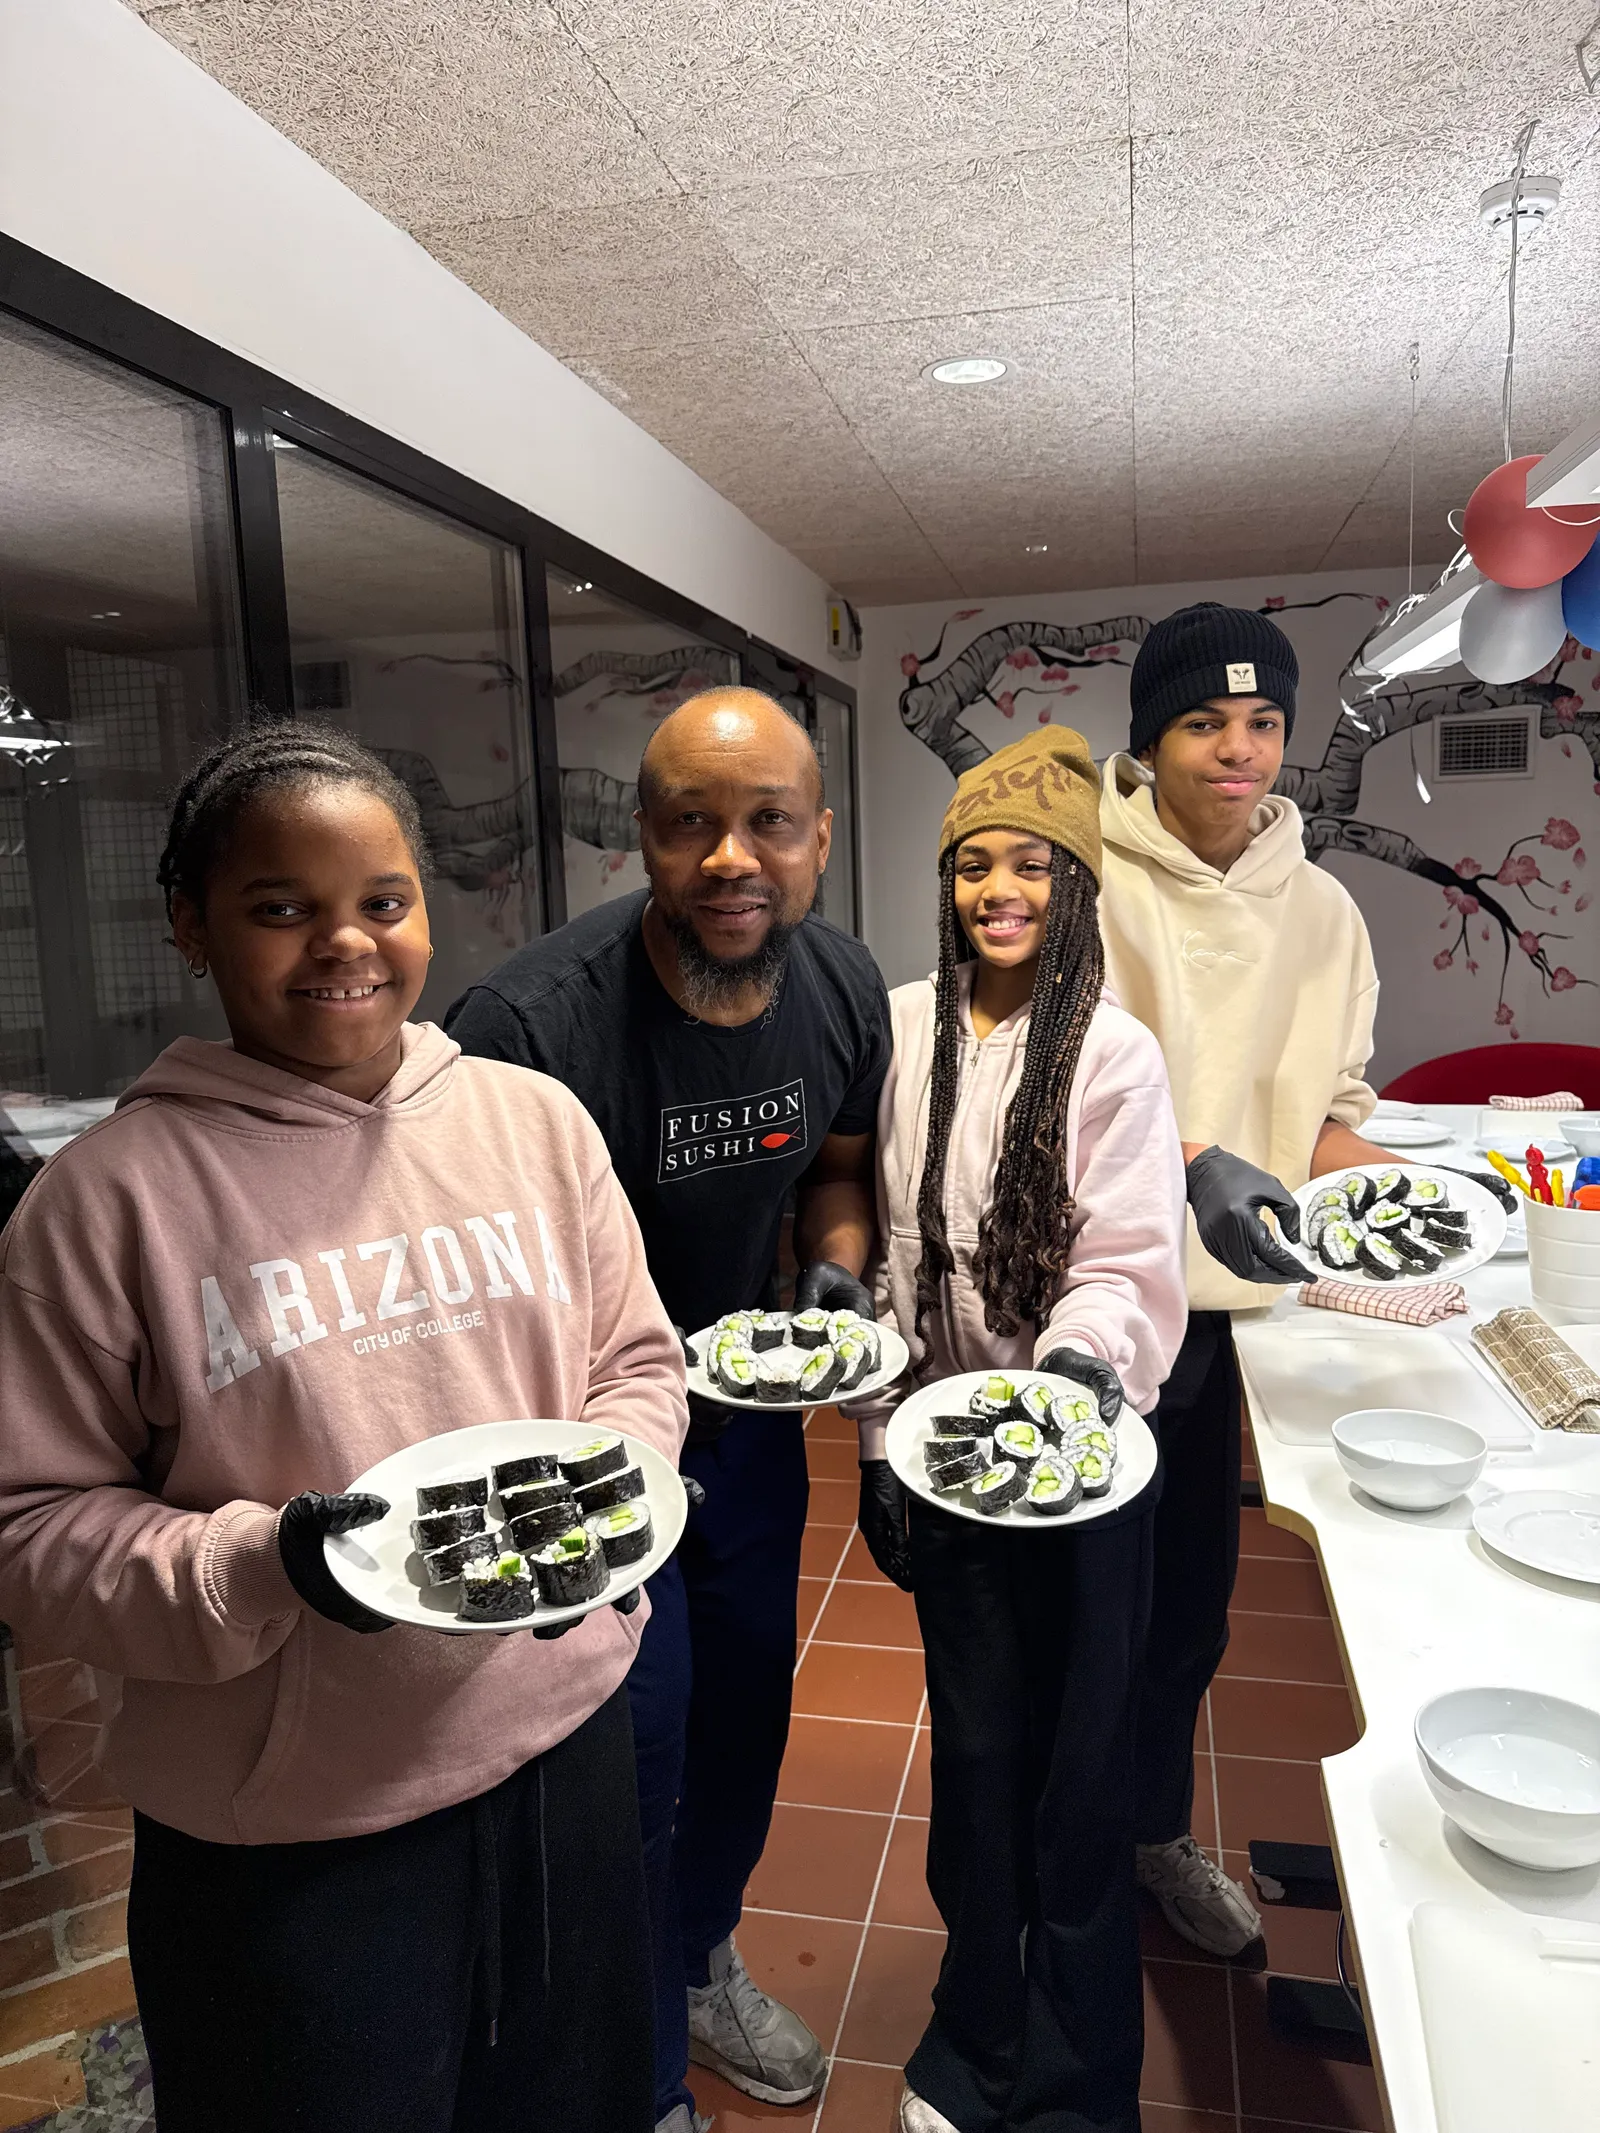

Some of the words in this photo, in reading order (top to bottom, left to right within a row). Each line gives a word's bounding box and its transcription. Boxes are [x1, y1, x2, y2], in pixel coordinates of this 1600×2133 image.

[667, 1092, 800, 1140] FUSION
[665, 1136, 756, 1171] SUSHI
[200, 1206, 572, 1394] ARIZONA
[352, 1331, 390, 1356] CITY
[391, 1325, 412, 1346] OF
[415, 1310, 484, 1339] COLLEGE
